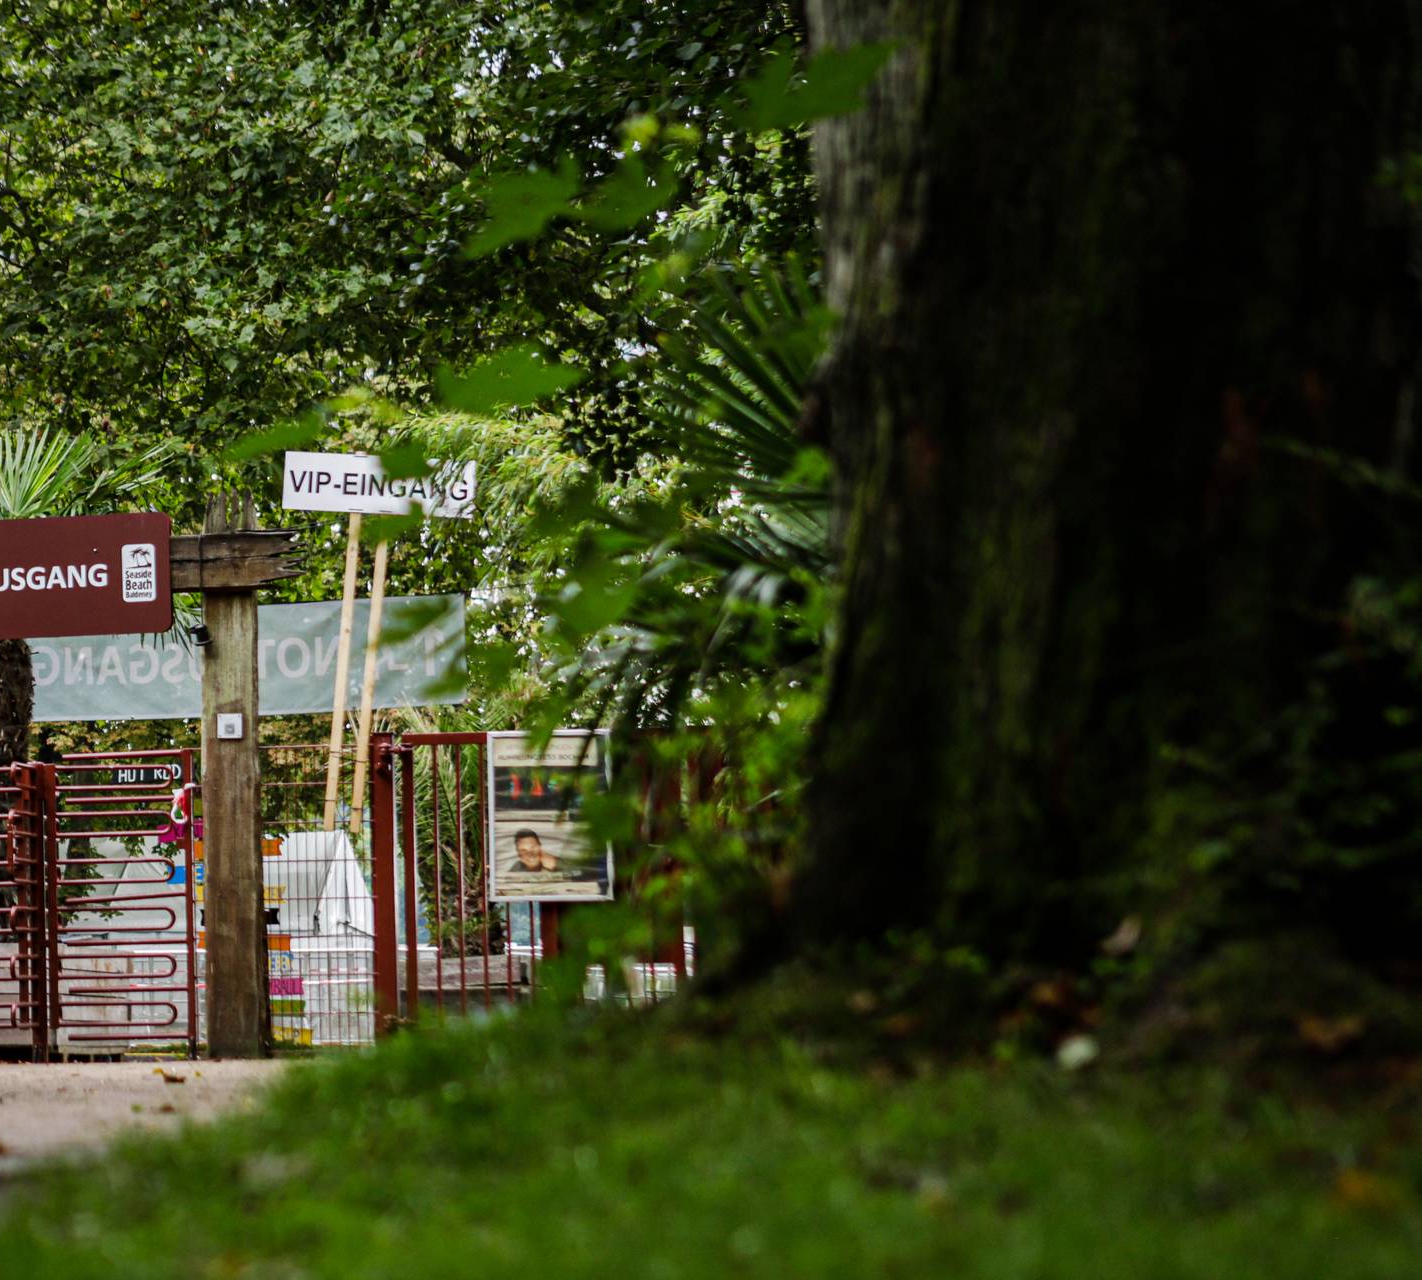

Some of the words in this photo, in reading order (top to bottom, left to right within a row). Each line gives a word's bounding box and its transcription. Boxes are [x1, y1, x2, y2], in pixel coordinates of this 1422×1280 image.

[125, 570, 152, 579] Seaside
[125, 579, 152, 591] Beach
[125, 591, 153, 599] Baldeney
